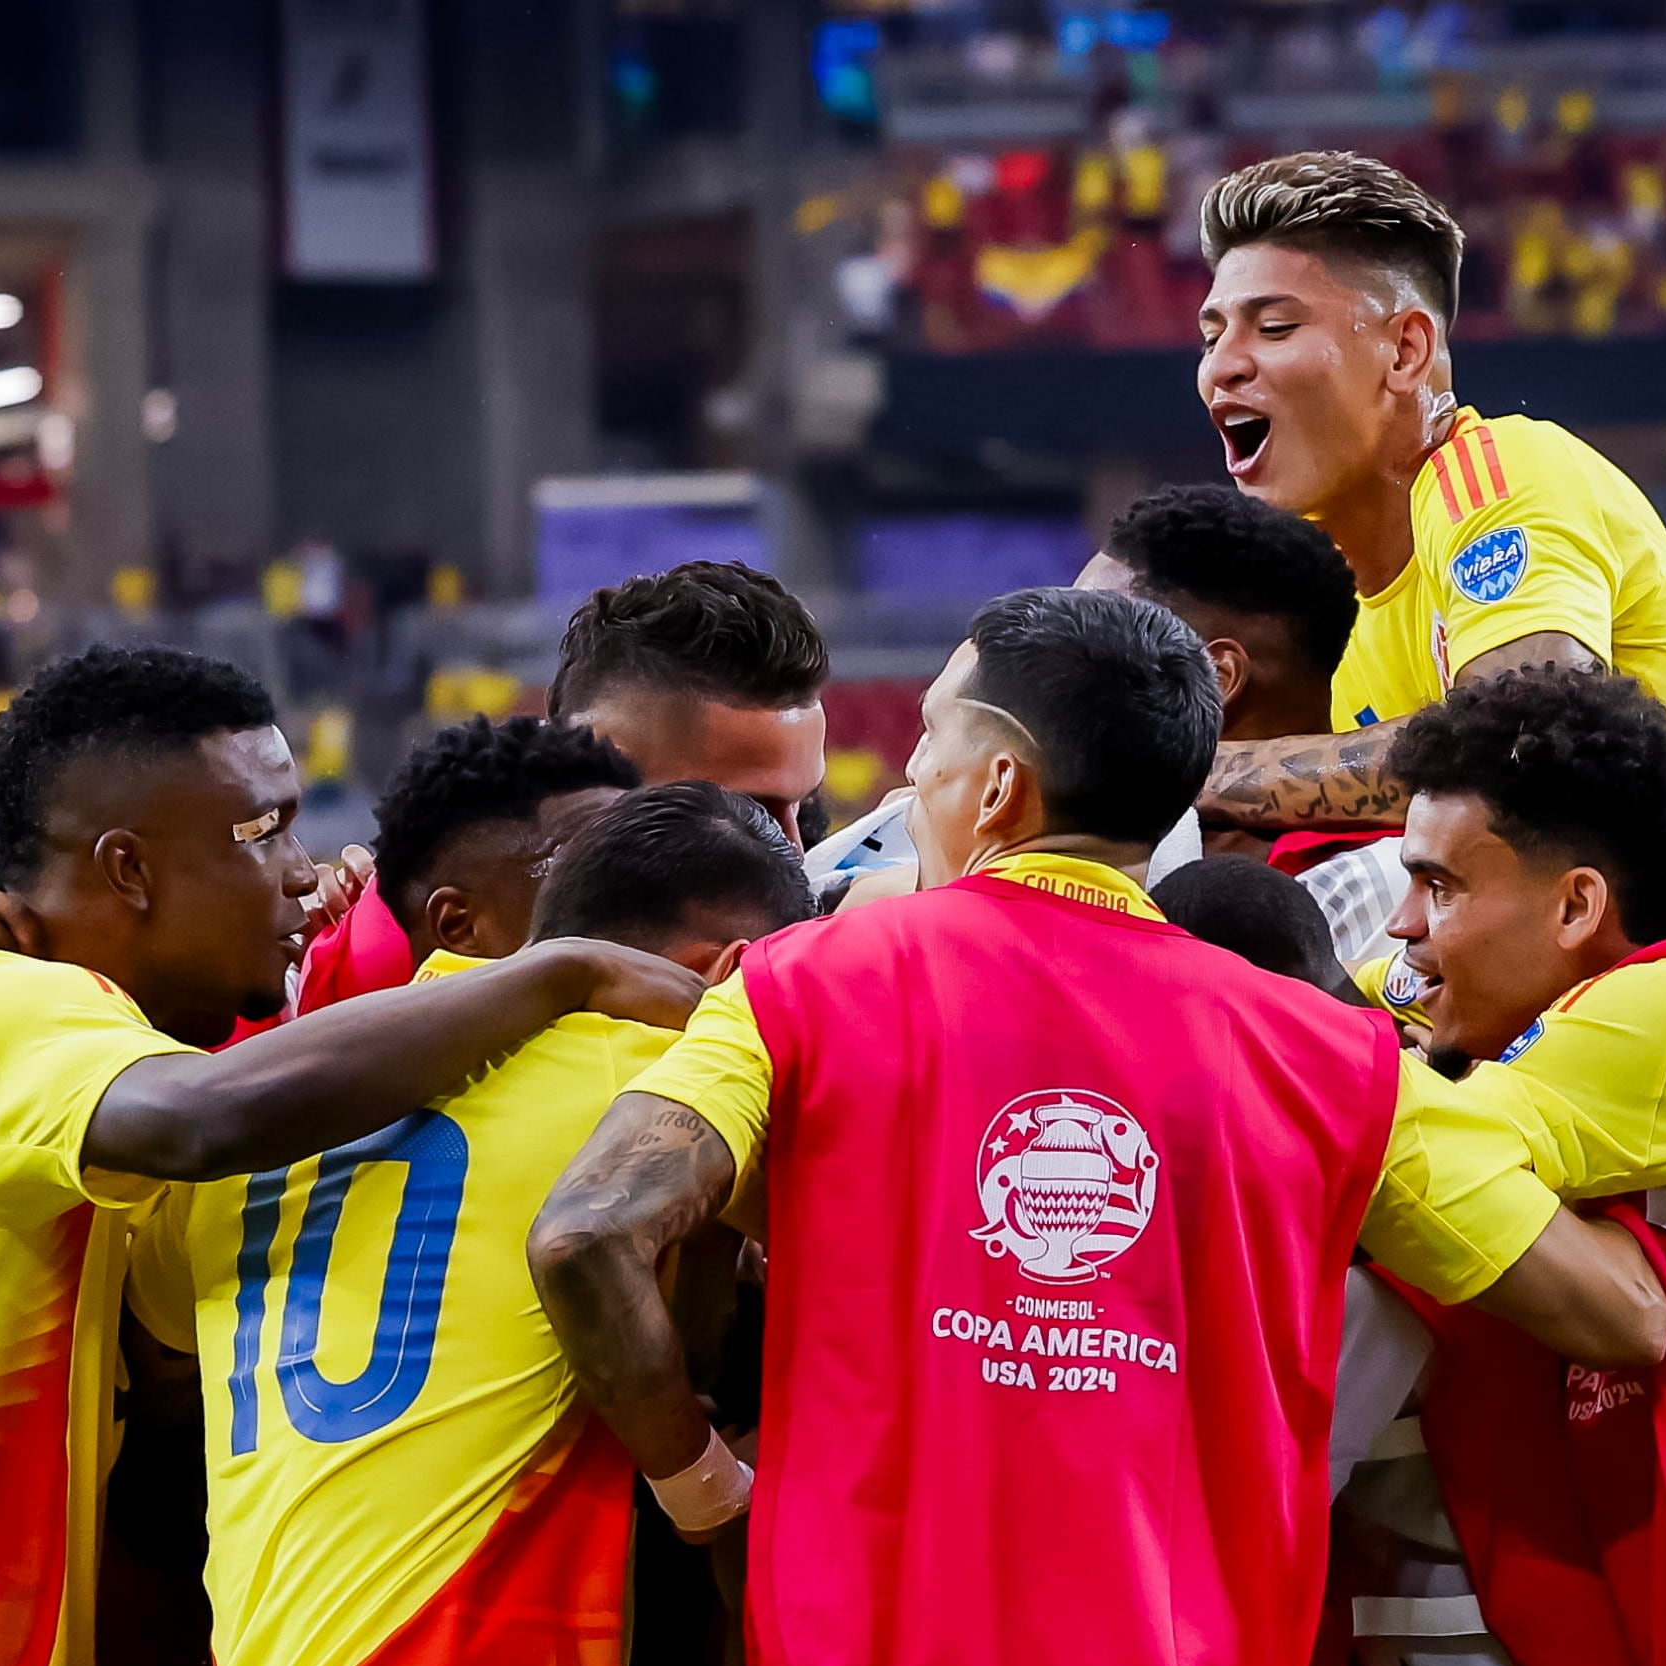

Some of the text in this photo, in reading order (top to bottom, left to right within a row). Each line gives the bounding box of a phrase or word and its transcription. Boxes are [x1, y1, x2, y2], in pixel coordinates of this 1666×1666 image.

[1464, 543, 1518, 581] VIBRA
[228, 1108, 470, 1457] 10
[932, 1308, 1178, 1374] COPA AMERICA
[982, 1358, 1117, 1393] USA 2024
